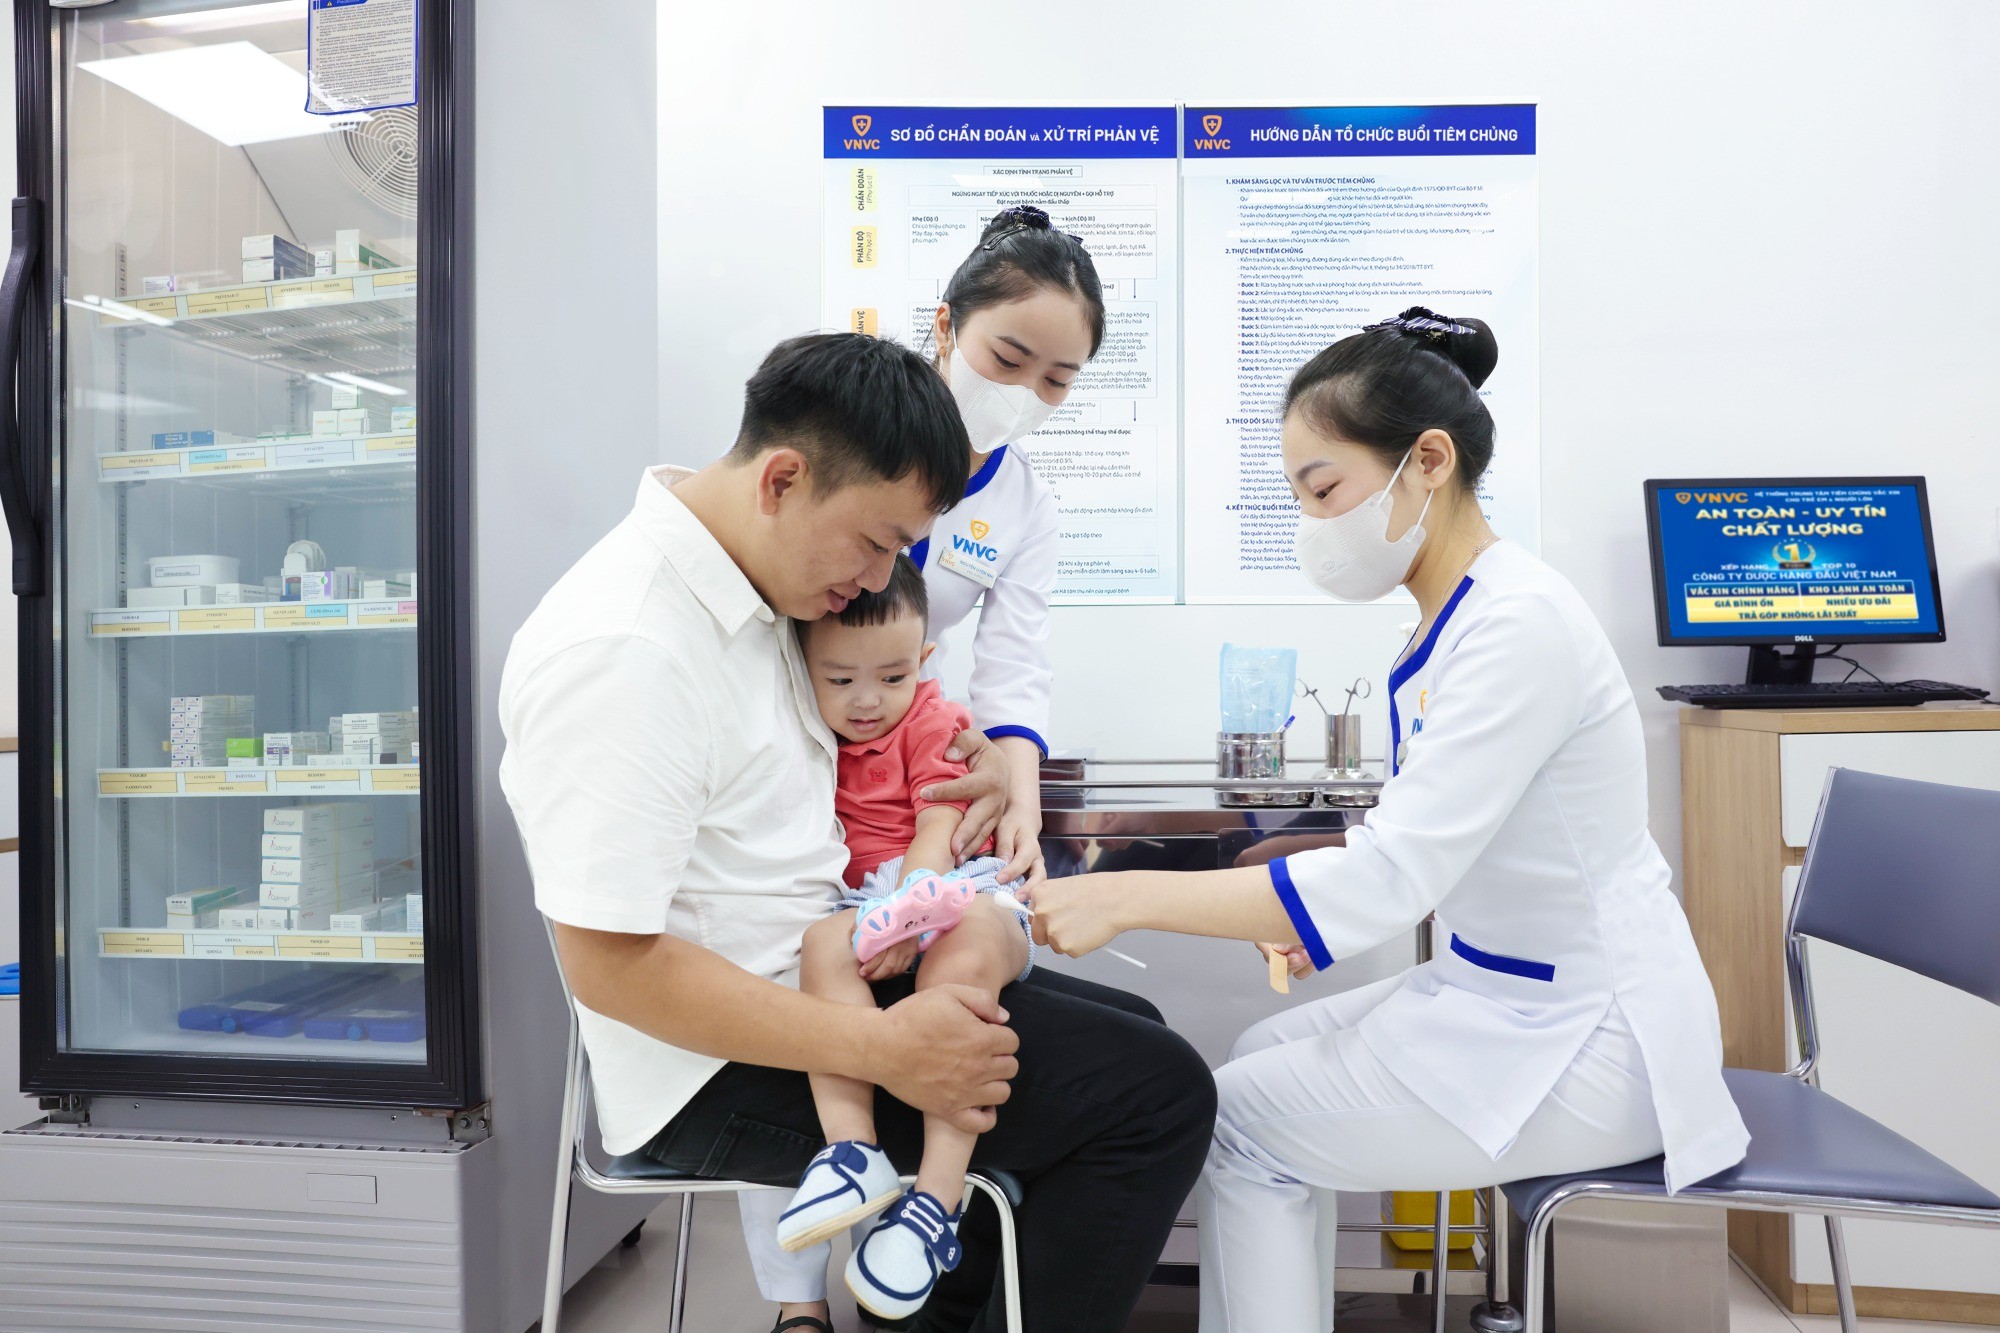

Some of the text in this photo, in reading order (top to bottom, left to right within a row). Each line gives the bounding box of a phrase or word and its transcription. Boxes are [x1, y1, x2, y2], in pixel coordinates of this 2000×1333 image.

[891, 123, 1160, 144] SƠ ĐỒ CHẨN ĐOÁN VÀ XỬ TRÍ PHẢN VỆ
[1250, 124, 1518, 142] HƯỚNG DẪN TỔ CHỨC BUỔI TIÊM CHỦNG
[844, 139, 880, 150] VNVC
[1194, 138, 1231, 150] VNVC
[1694, 492, 1748, 503] VNVC
[1696, 509, 1728, 519] AN
[1733, 505, 1796, 519] TOÀN
[1816, 507, 1845, 518] UY
[1850, 504, 1887, 517] TÍN
[1722, 521, 1863, 538] CHẤT LƯỢNG
[953, 534, 998, 562] VNVC
[1693, 572, 1725, 581] CÔNG
[1746, 572, 1776, 582] DƯỢC
[1779, 570, 1812, 580] HÀNG
[1816, 569, 1839, 579] ĐẦU
[1842, 570, 1867, 580] VIỆT
[1690, 586, 1710, 595] VẮC
[1732, 585, 1764, 595] CHÍNH
[1767, 586, 1795, 594] HÃNG
[1832, 586, 1859, 595] LẠNH
[1878, 584, 1905, 592] TOÀN
[1715, 599, 1731, 608] GIÁ
[1760, 598, 1774, 607] ỔN
[1826, 596, 1856, 606] NHIỀU
[1875, 597, 1891, 605] ĐÃI
[1738, 608, 1857, 620] TRẢ GÓP KHÔNG LÃI SUẤT
